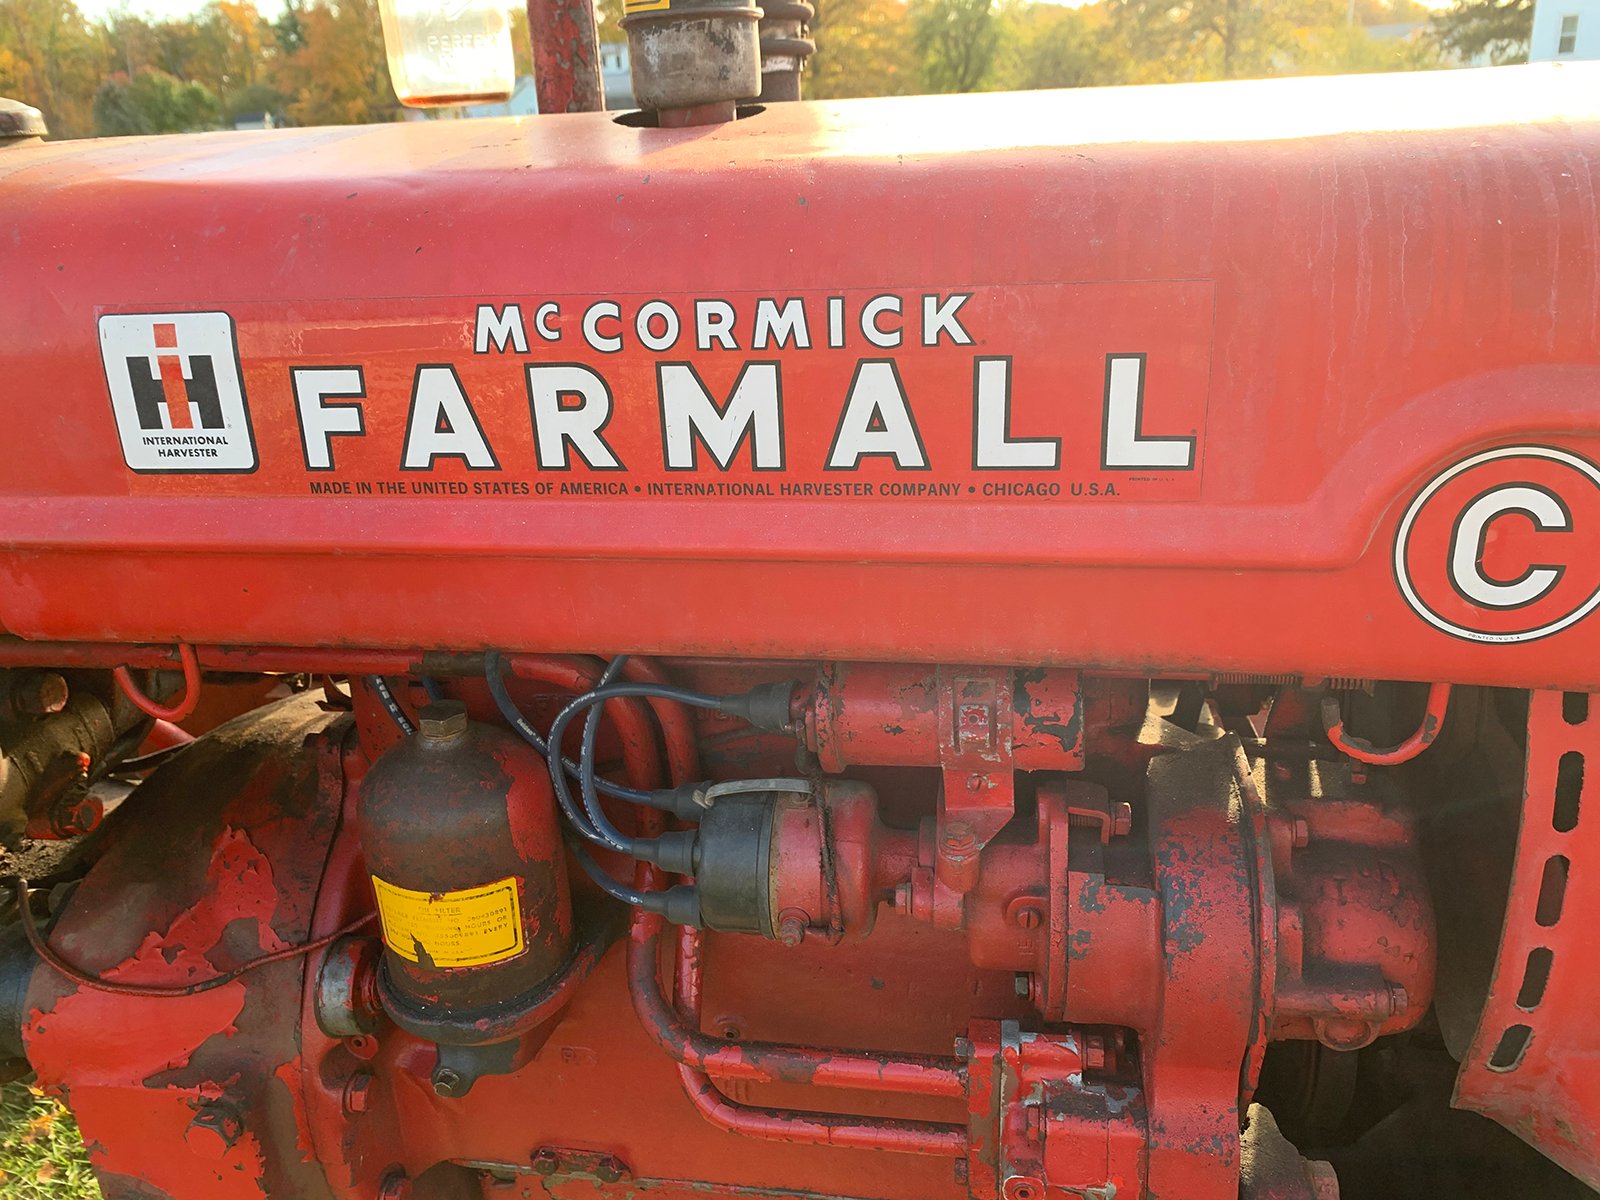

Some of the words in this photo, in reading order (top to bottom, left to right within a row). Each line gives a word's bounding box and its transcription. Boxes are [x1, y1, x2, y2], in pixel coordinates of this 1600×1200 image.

[289, 352, 1197, 472] FARMALL
[142, 436, 228, 446] INTERNATIONAL
[158, 448, 218, 458] HARVESTER
[309, 481, 352, 495] MADE
[355, 481, 372, 495] IN
[376, 481, 408, 495] THE
[411, 481, 469, 495] UNITED
[473, 481, 530, 496] STATES
[535, 481, 554, 496] OF
[559, 481, 629, 496] AMERICA
[647, 481, 775, 497] INTERNATIONAL
[780, 481, 874, 497] HARVESTER
[879, 481, 962, 497] COMPANY
[981, 481, 1061, 497] CHICAGO
[1069, 481, 1121, 497] U.S.A.
[1447, 481, 1575, 611] C
